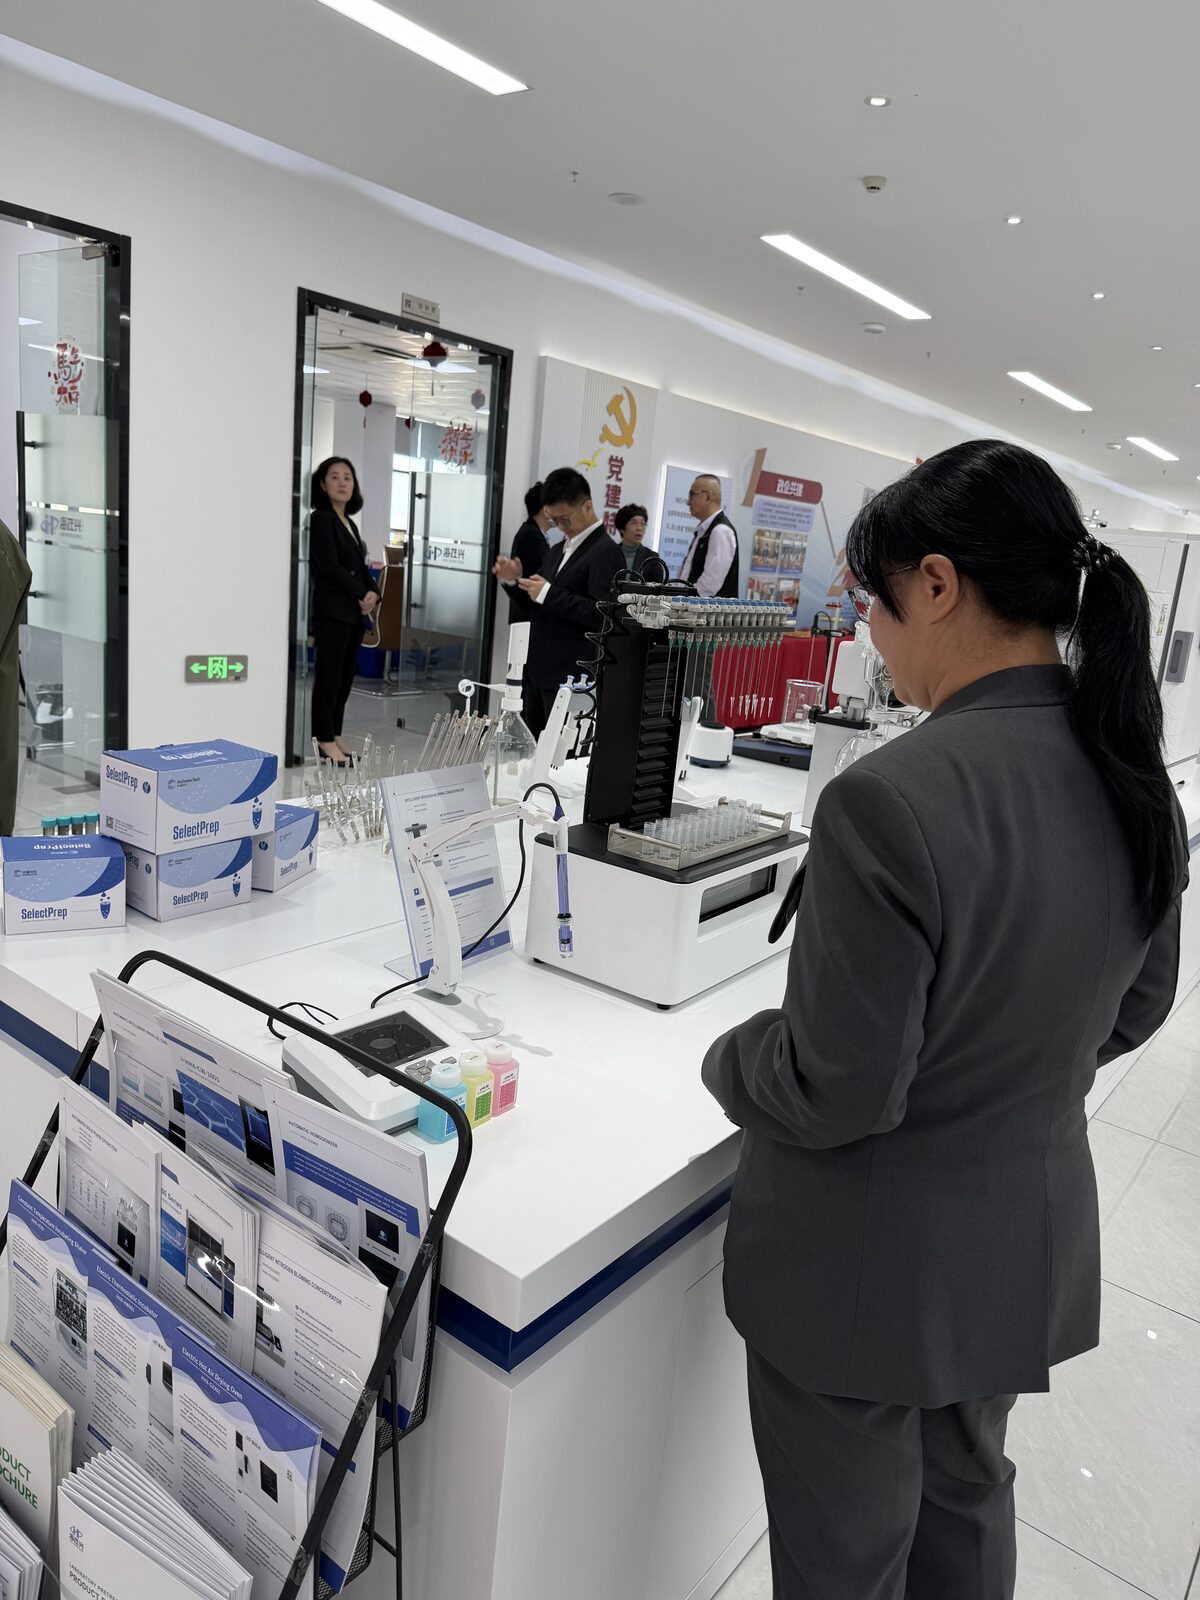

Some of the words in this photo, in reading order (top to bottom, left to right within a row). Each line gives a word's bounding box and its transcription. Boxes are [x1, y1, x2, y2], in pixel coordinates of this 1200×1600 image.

[106, 765, 138, 792] SelectPrep
[173, 820, 220, 841] SelectPrep
[173, 890, 209, 906] SelectPrep
[21, 906, 68, 920] SelectPrep
[33, 1207, 56, 1230] Temperature
[96, 1265, 111, 1282] Electric
[111, 1277, 138, 1304] Thermostatic
[137, 1299, 159, 1319] Incubator
[181, 1346, 199, 1365] Electric
[198, 1360, 208, 1371] Hot
[207, 1368, 215, 1377] Air
[214, 1373, 230, 1392] Drying
[230, 1385, 243, 1400] Oven
[0, 1446, 31, 1482] DUCT
[69, 1570, 99, 1600] PRODUCT
[97, 1585, 119, 1600] PRETRE
